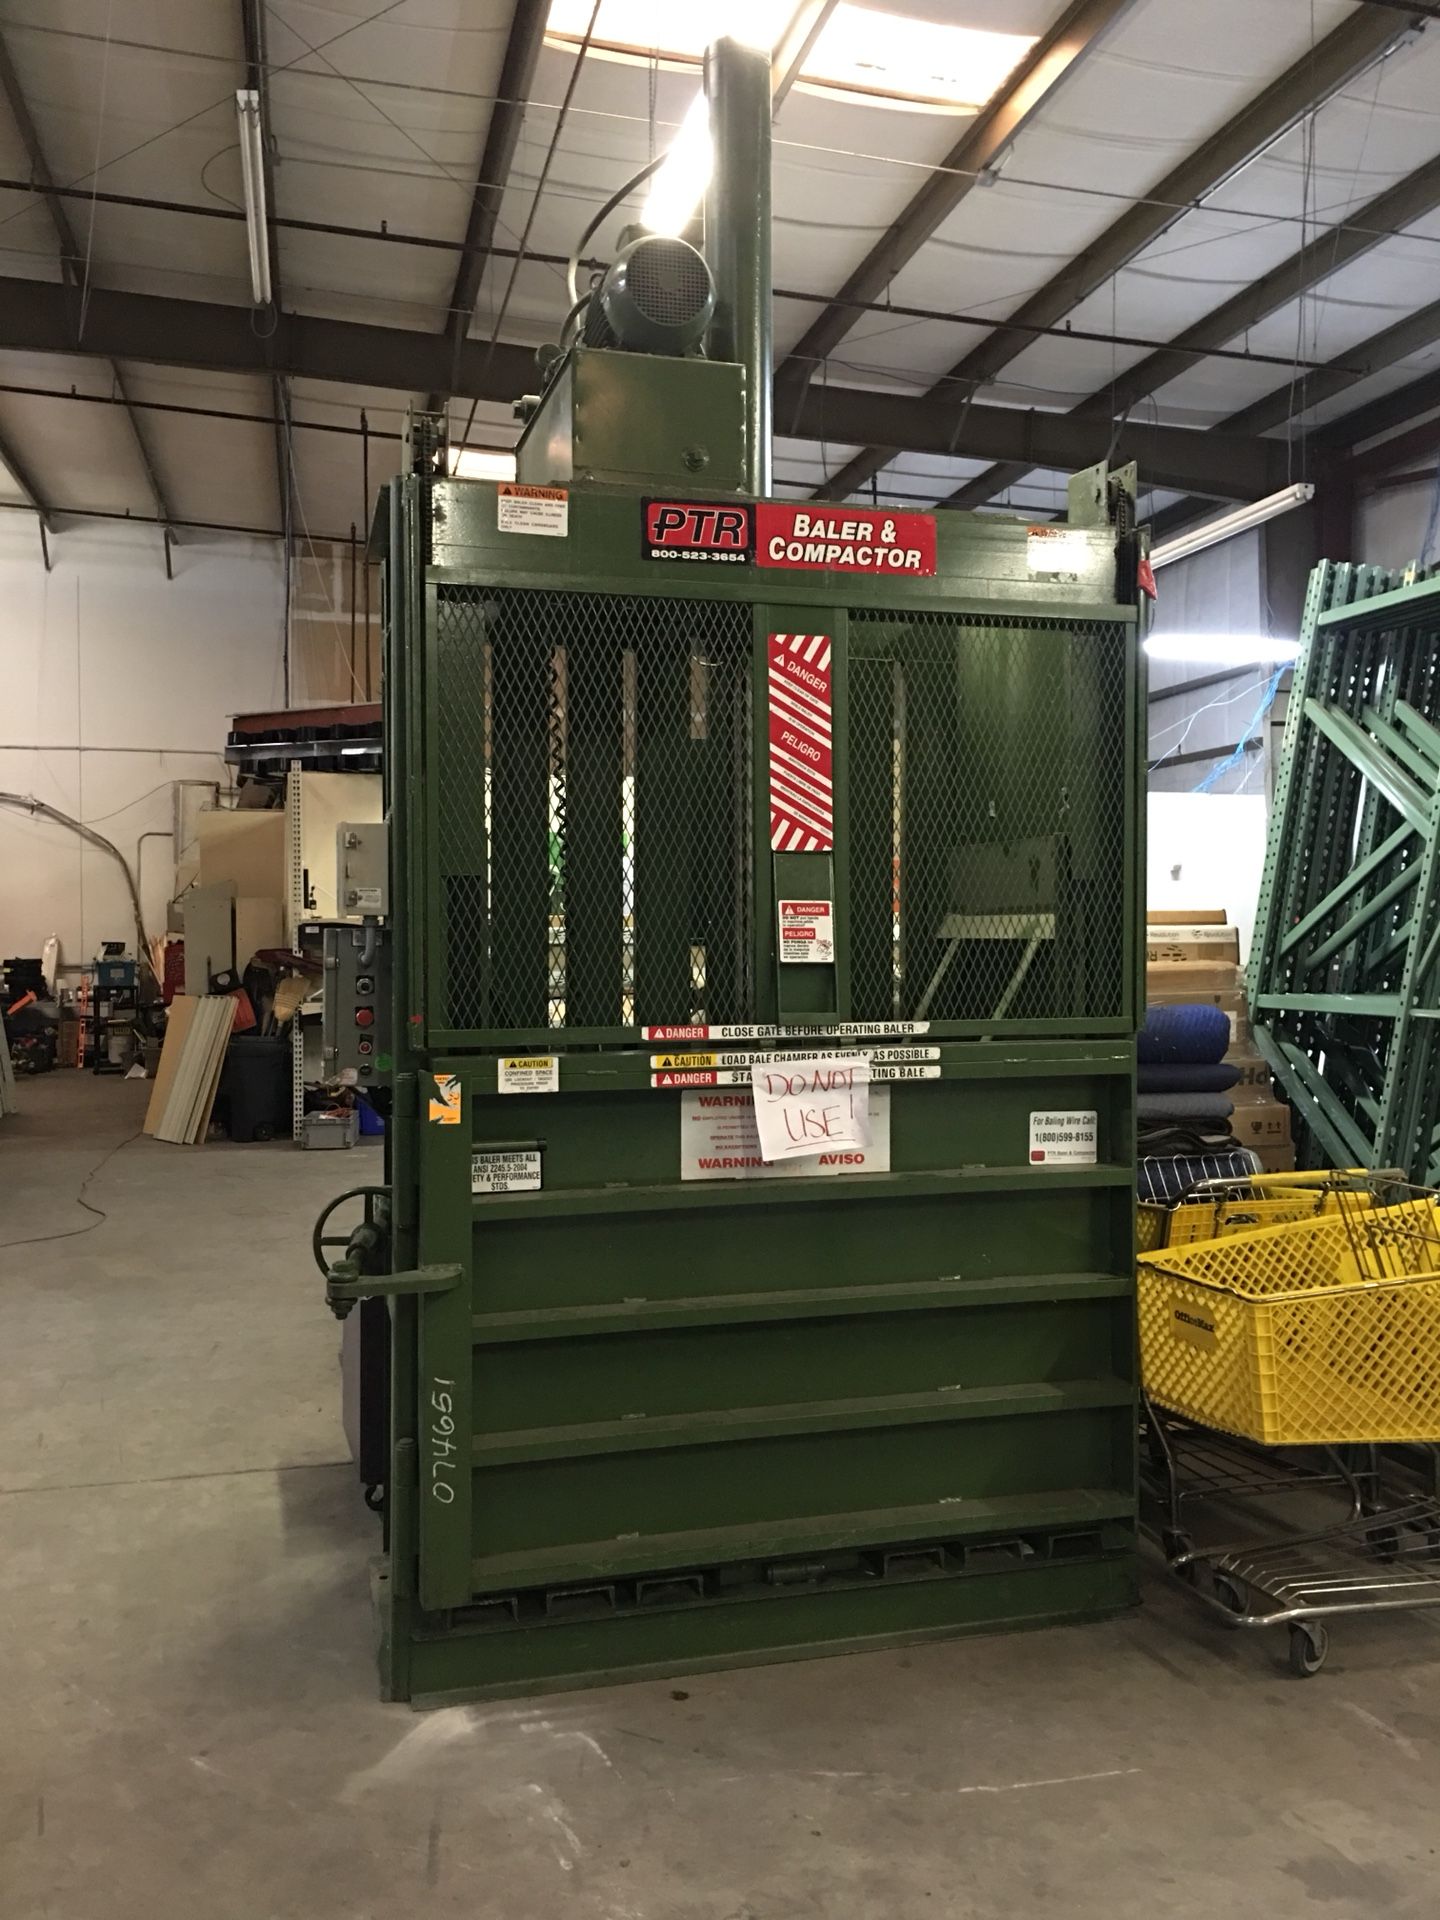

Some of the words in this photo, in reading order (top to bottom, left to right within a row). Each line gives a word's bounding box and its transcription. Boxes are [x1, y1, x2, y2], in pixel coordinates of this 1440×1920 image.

[514, 487, 563, 500] WARNING
[652, 506, 745, 545] PTR
[793, 514, 873, 542] BALER
[880, 519, 896, 543] &
[651, 549, 746, 563] 800-523-3654
[769, 537, 922, 569] COMPACTOR
[787, 661, 828, 693] DANGER
[781, 730, 821, 762] PELIGRO
[666, 1027, 704, 1039] DANGER
[721, 1027, 754, 1038] CLOSE
[757, 1026, 782, 1037] GATE
[785, 1025, 823, 1036] BEFORE
[826, 1024, 881, 1036] OPERATING
[883, 1023, 914, 1034] BALER
[518, 1059, 549, 1068] CAUTION
[674, 1055, 712, 1066] CAUTION
[721, 1054, 746, 1065] LOAD
[749, 1053, 772, 1064] BALE
[873, 1050, 885, 1060] AS
[887, 1049, 929, 1060] POSSIBLE
[674, 1073, 712, 1084] DANGER
[732, 1072, 753, 1083] STA
[899, 1067, 925, 1078] BALE
[766, 1073, 806, 1102] DO
[811, 1066, 864, 1093] NOT
[698, 1095, 754, 1107] WARNI
[1033, 1116, 1044, 1126] For
[1066, 1116, 1081, 1125] Wire
[480, 1155, 500, 1164] BALER
[502, 1154, 524, 1163] MEETS
[525, 1153, 537, 1162] ALL
[819, 1153, 865, 1165] AVISO
[473, 1165, 488, 1174] ANSI
[486, 1173, 491, 1182] &
[493, 1171, 540, 1182] PERFORMANCE
